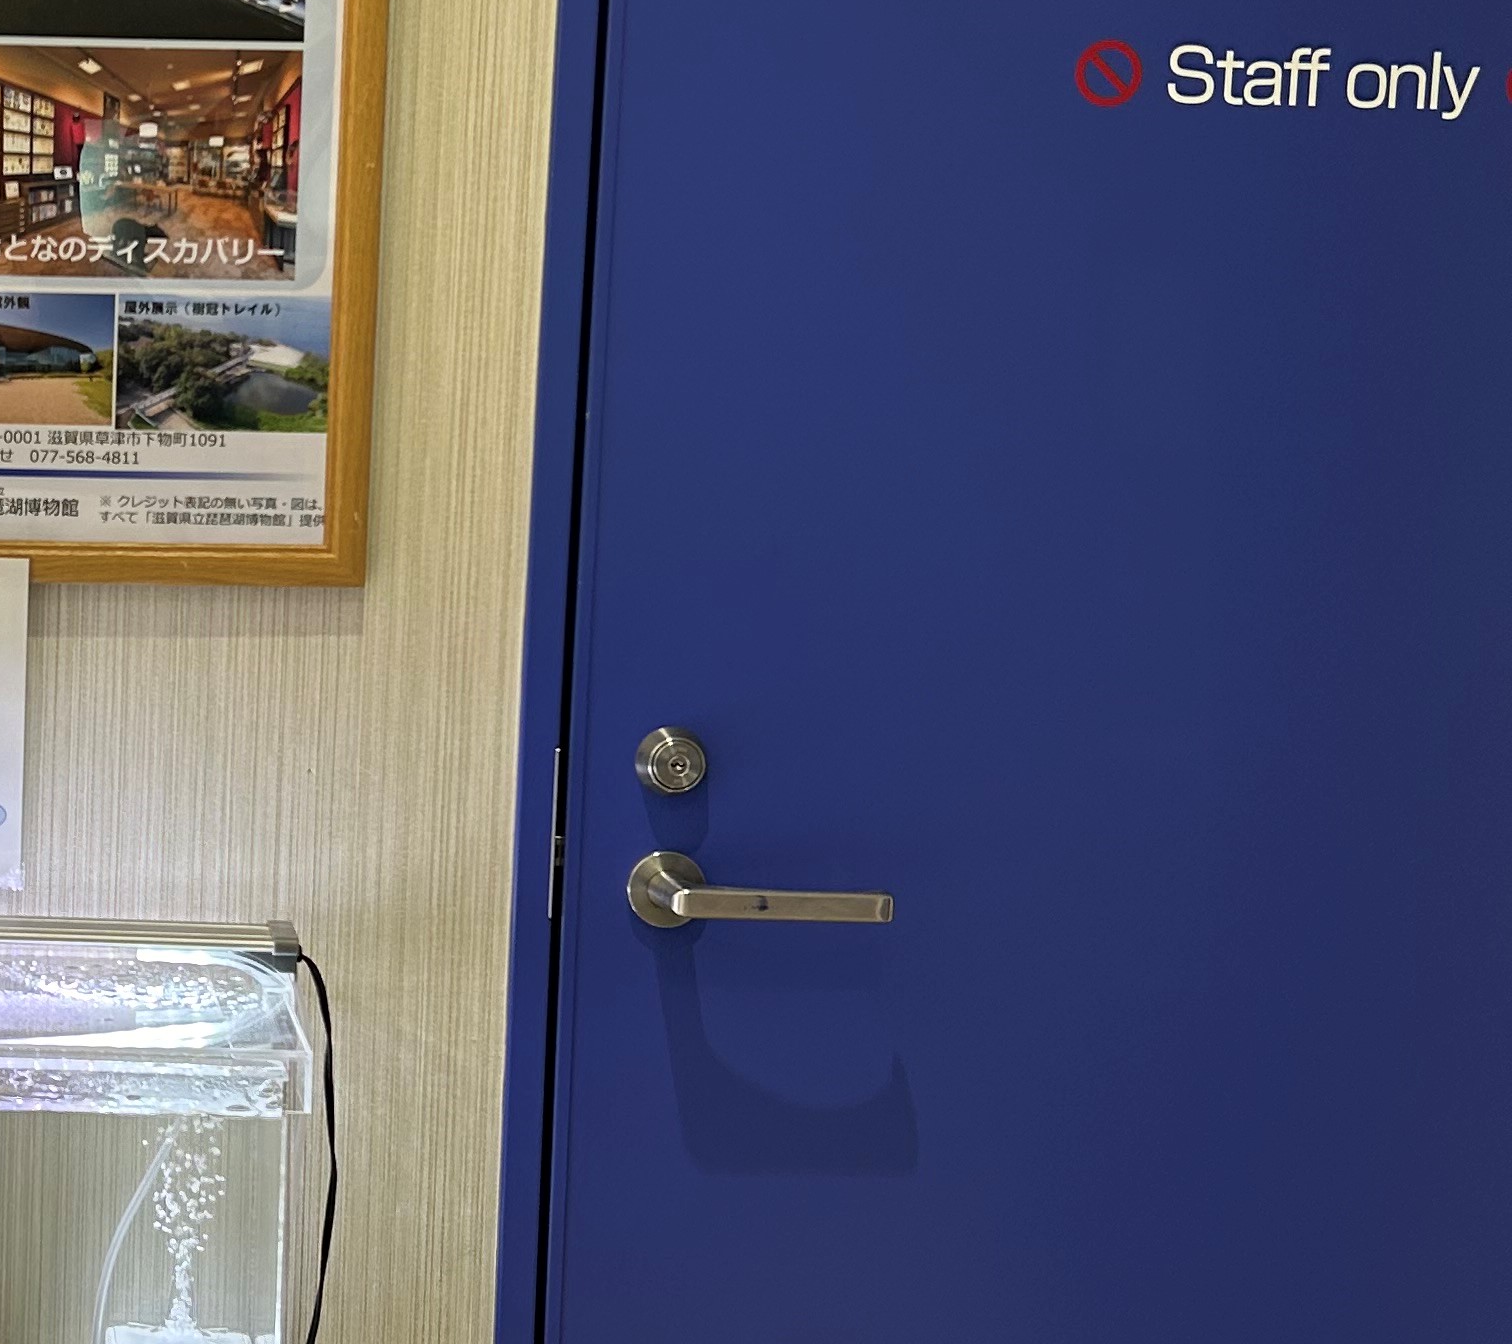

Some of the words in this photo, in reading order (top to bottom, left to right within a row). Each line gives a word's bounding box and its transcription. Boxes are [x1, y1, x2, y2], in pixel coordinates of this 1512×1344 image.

[1167, 44, 1331, 107] Staff
[1346, 51, 1480, 120] only
[47, 429, 227, 448] 滋賀県草津市下物町1091
[29, 449, 140, 465] 077-568-4811
